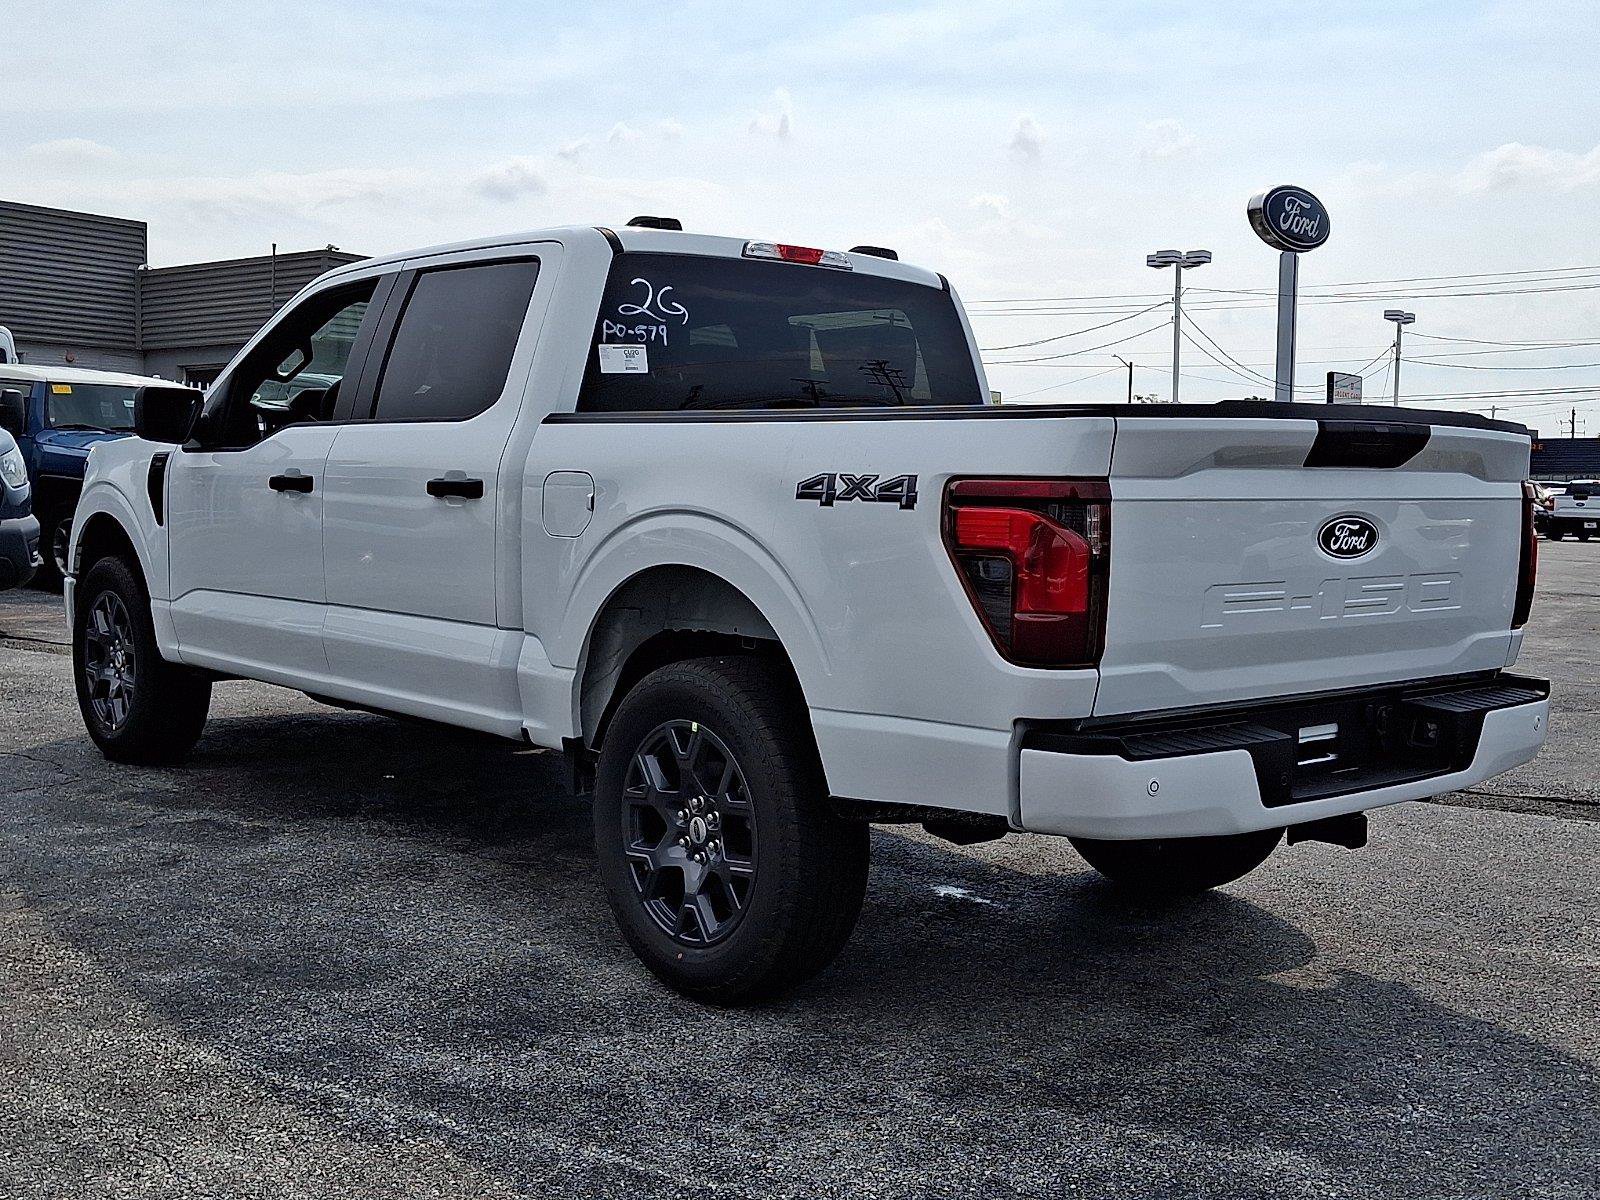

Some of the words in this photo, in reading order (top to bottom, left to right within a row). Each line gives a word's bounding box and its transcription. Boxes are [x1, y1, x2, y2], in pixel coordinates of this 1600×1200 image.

[1280, 196, 1320, 238] Ford
[1330, 522, 1369, 550] Ford
[1200, 571, 1464, 629] F-150
